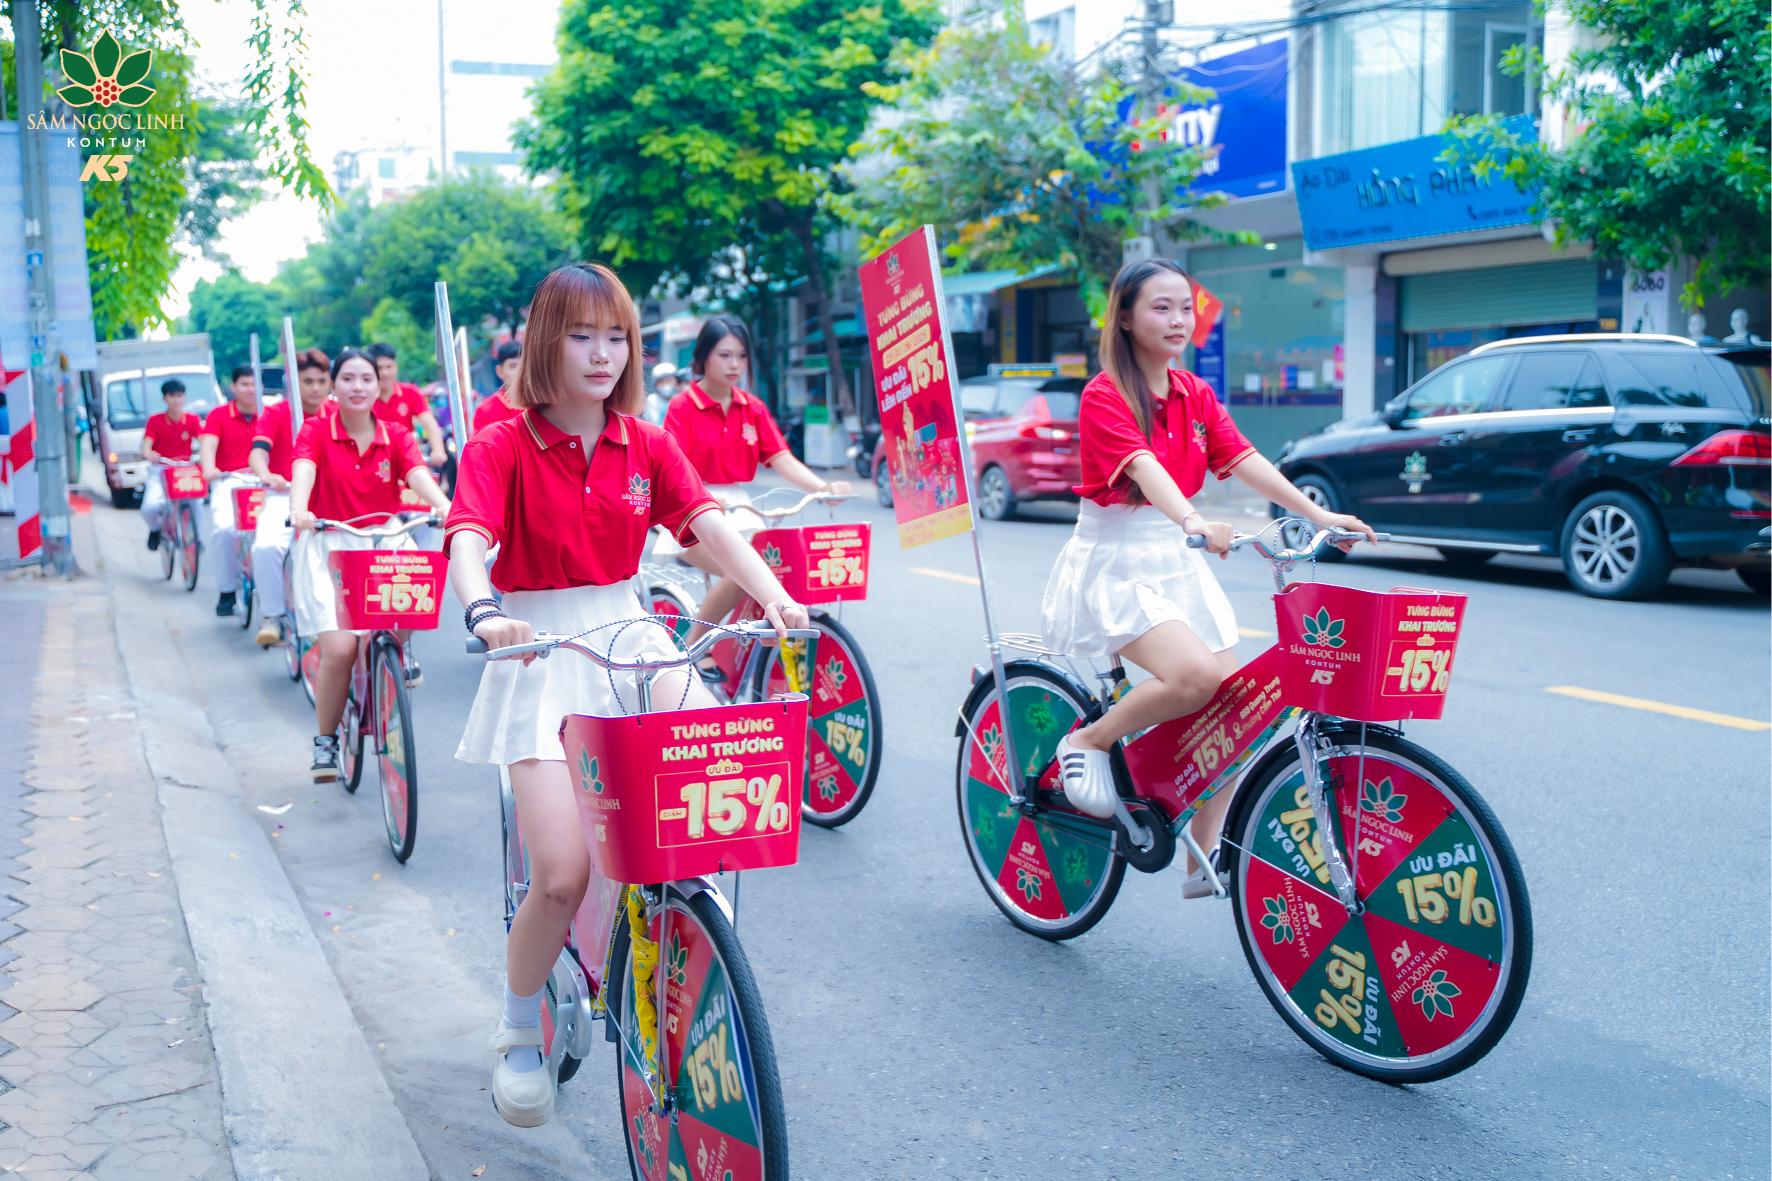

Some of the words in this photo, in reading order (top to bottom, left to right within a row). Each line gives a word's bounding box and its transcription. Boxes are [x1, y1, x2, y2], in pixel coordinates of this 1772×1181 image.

[908, 341, 944, 394] 15%
[1398, 620, 1421, 632] KHAI
[1422, 620, 1456, 632] TRƯƠNG
[1305, 660, 1341, 670] KONTUM
[1308, 648, 1334, 660] NGỌC
[1336, 651, 1360, 662] LINH
[1310, 669, 1336, 684] K5
[670, 722, 721, 740] TƯNG
[725, 716, 774, 736] BỪNG
[662, 744, 708, 762] KHAI
[710, 736, 784, 757] TRƯƠNG
[826, 720, 865, 767] 15%
[1192, 724, 1234, 779] 15%
[1267, 817, 1296, 854] ĐÃI
[1388, 826, 1414, 844] LINH
[1292, 854, 1310, 878] ƯU
[1410, 856, 1434, 874] ƯU
[1436, 842, 1478, 868] ĐÃI
[1396, 866, 1496, 928] 15%
[1288, 904, 1303, 936] NGỌC
[1304, 901, 1322, 928] K5
[1298, 937, 1310, 958] SÂM
[1391, 940, 1411, 968] K5
[1428, 945, 1449, 965] SÂM
[1396, 950, 1426, 980] KONTUM
[1314, 944, 1366, 1034] 15%
[1366, 976, 1380, 1003] ƯU
[1391, 981, 1412, 1002] LINH
[692, 1019, 704, 1046] ƯU
[704, 993, 726, 1032] ĐÃI
[1364, 1004, 1382, 1046] ĐÃI
[686, 1023, 742, 1113] 15%
